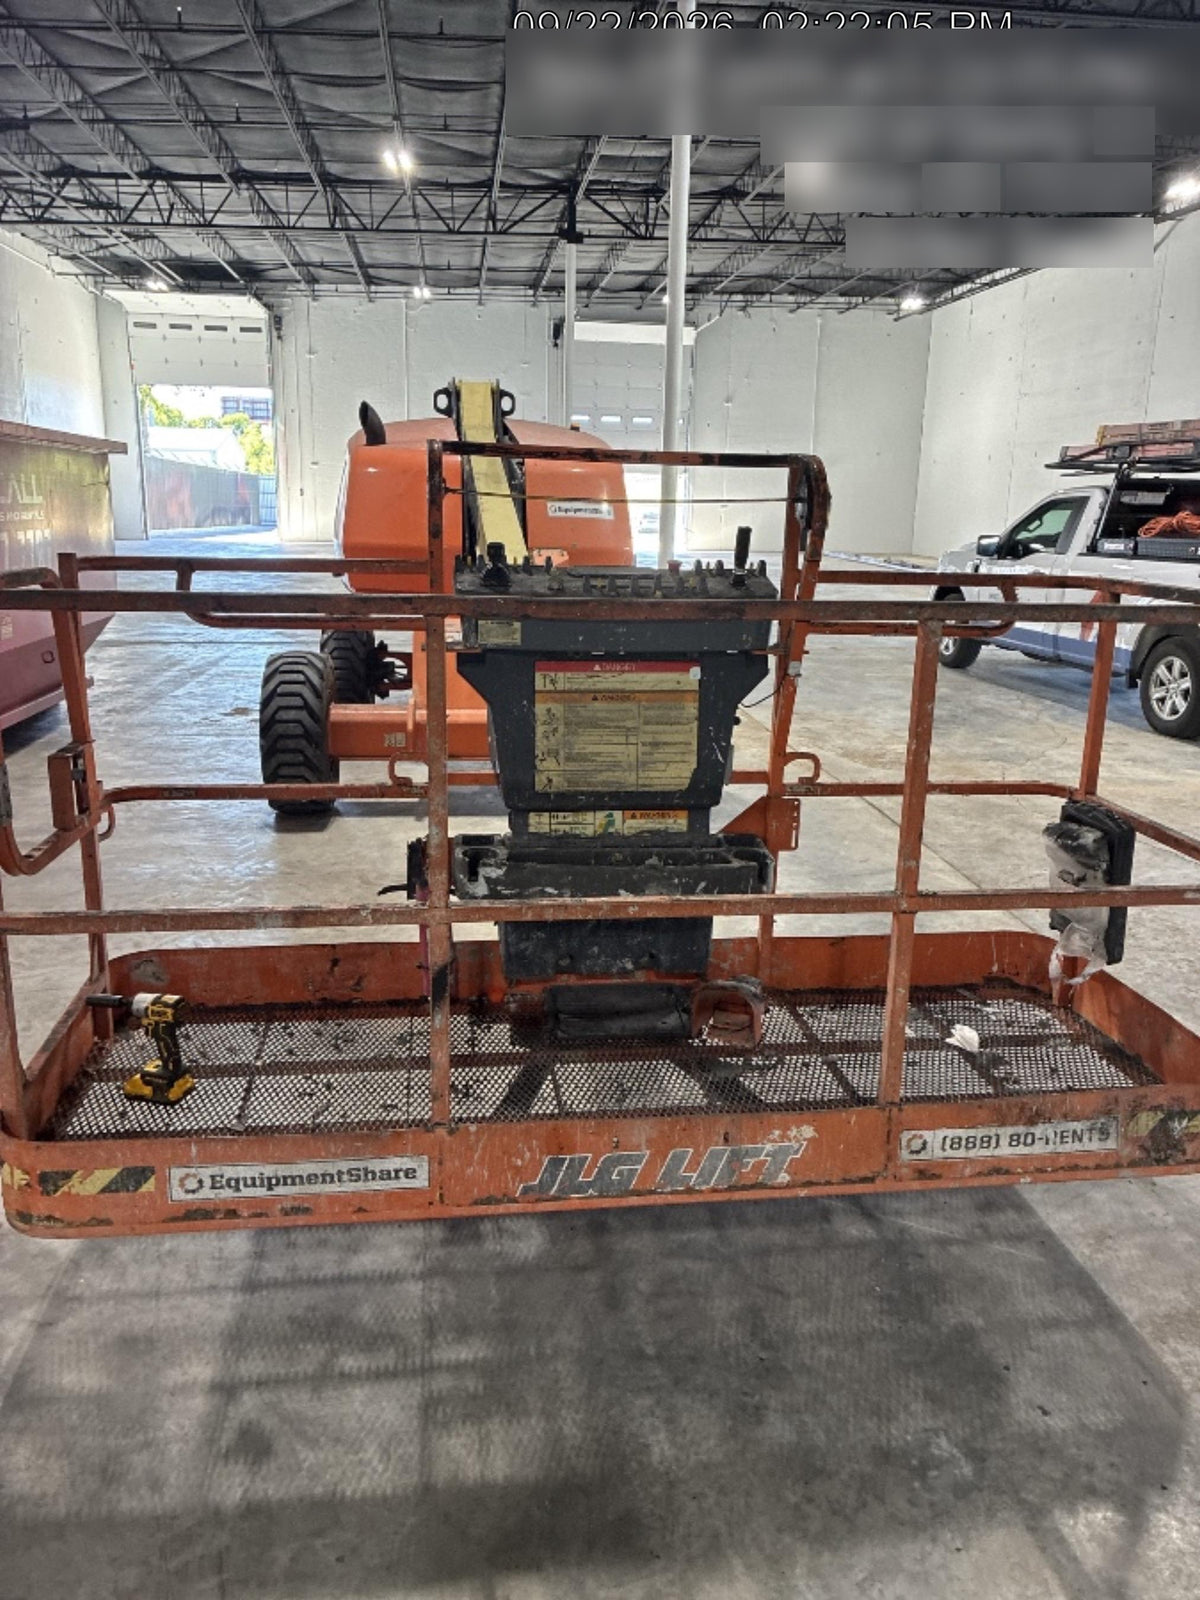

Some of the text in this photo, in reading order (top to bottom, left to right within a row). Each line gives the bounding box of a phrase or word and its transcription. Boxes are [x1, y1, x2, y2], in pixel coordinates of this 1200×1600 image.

[941, 1132, 1000, 1152] (888)
[208, 1167, 418, 1193] EquipmentShare
[515, 1140, 807, 1198] JLG LIFT
